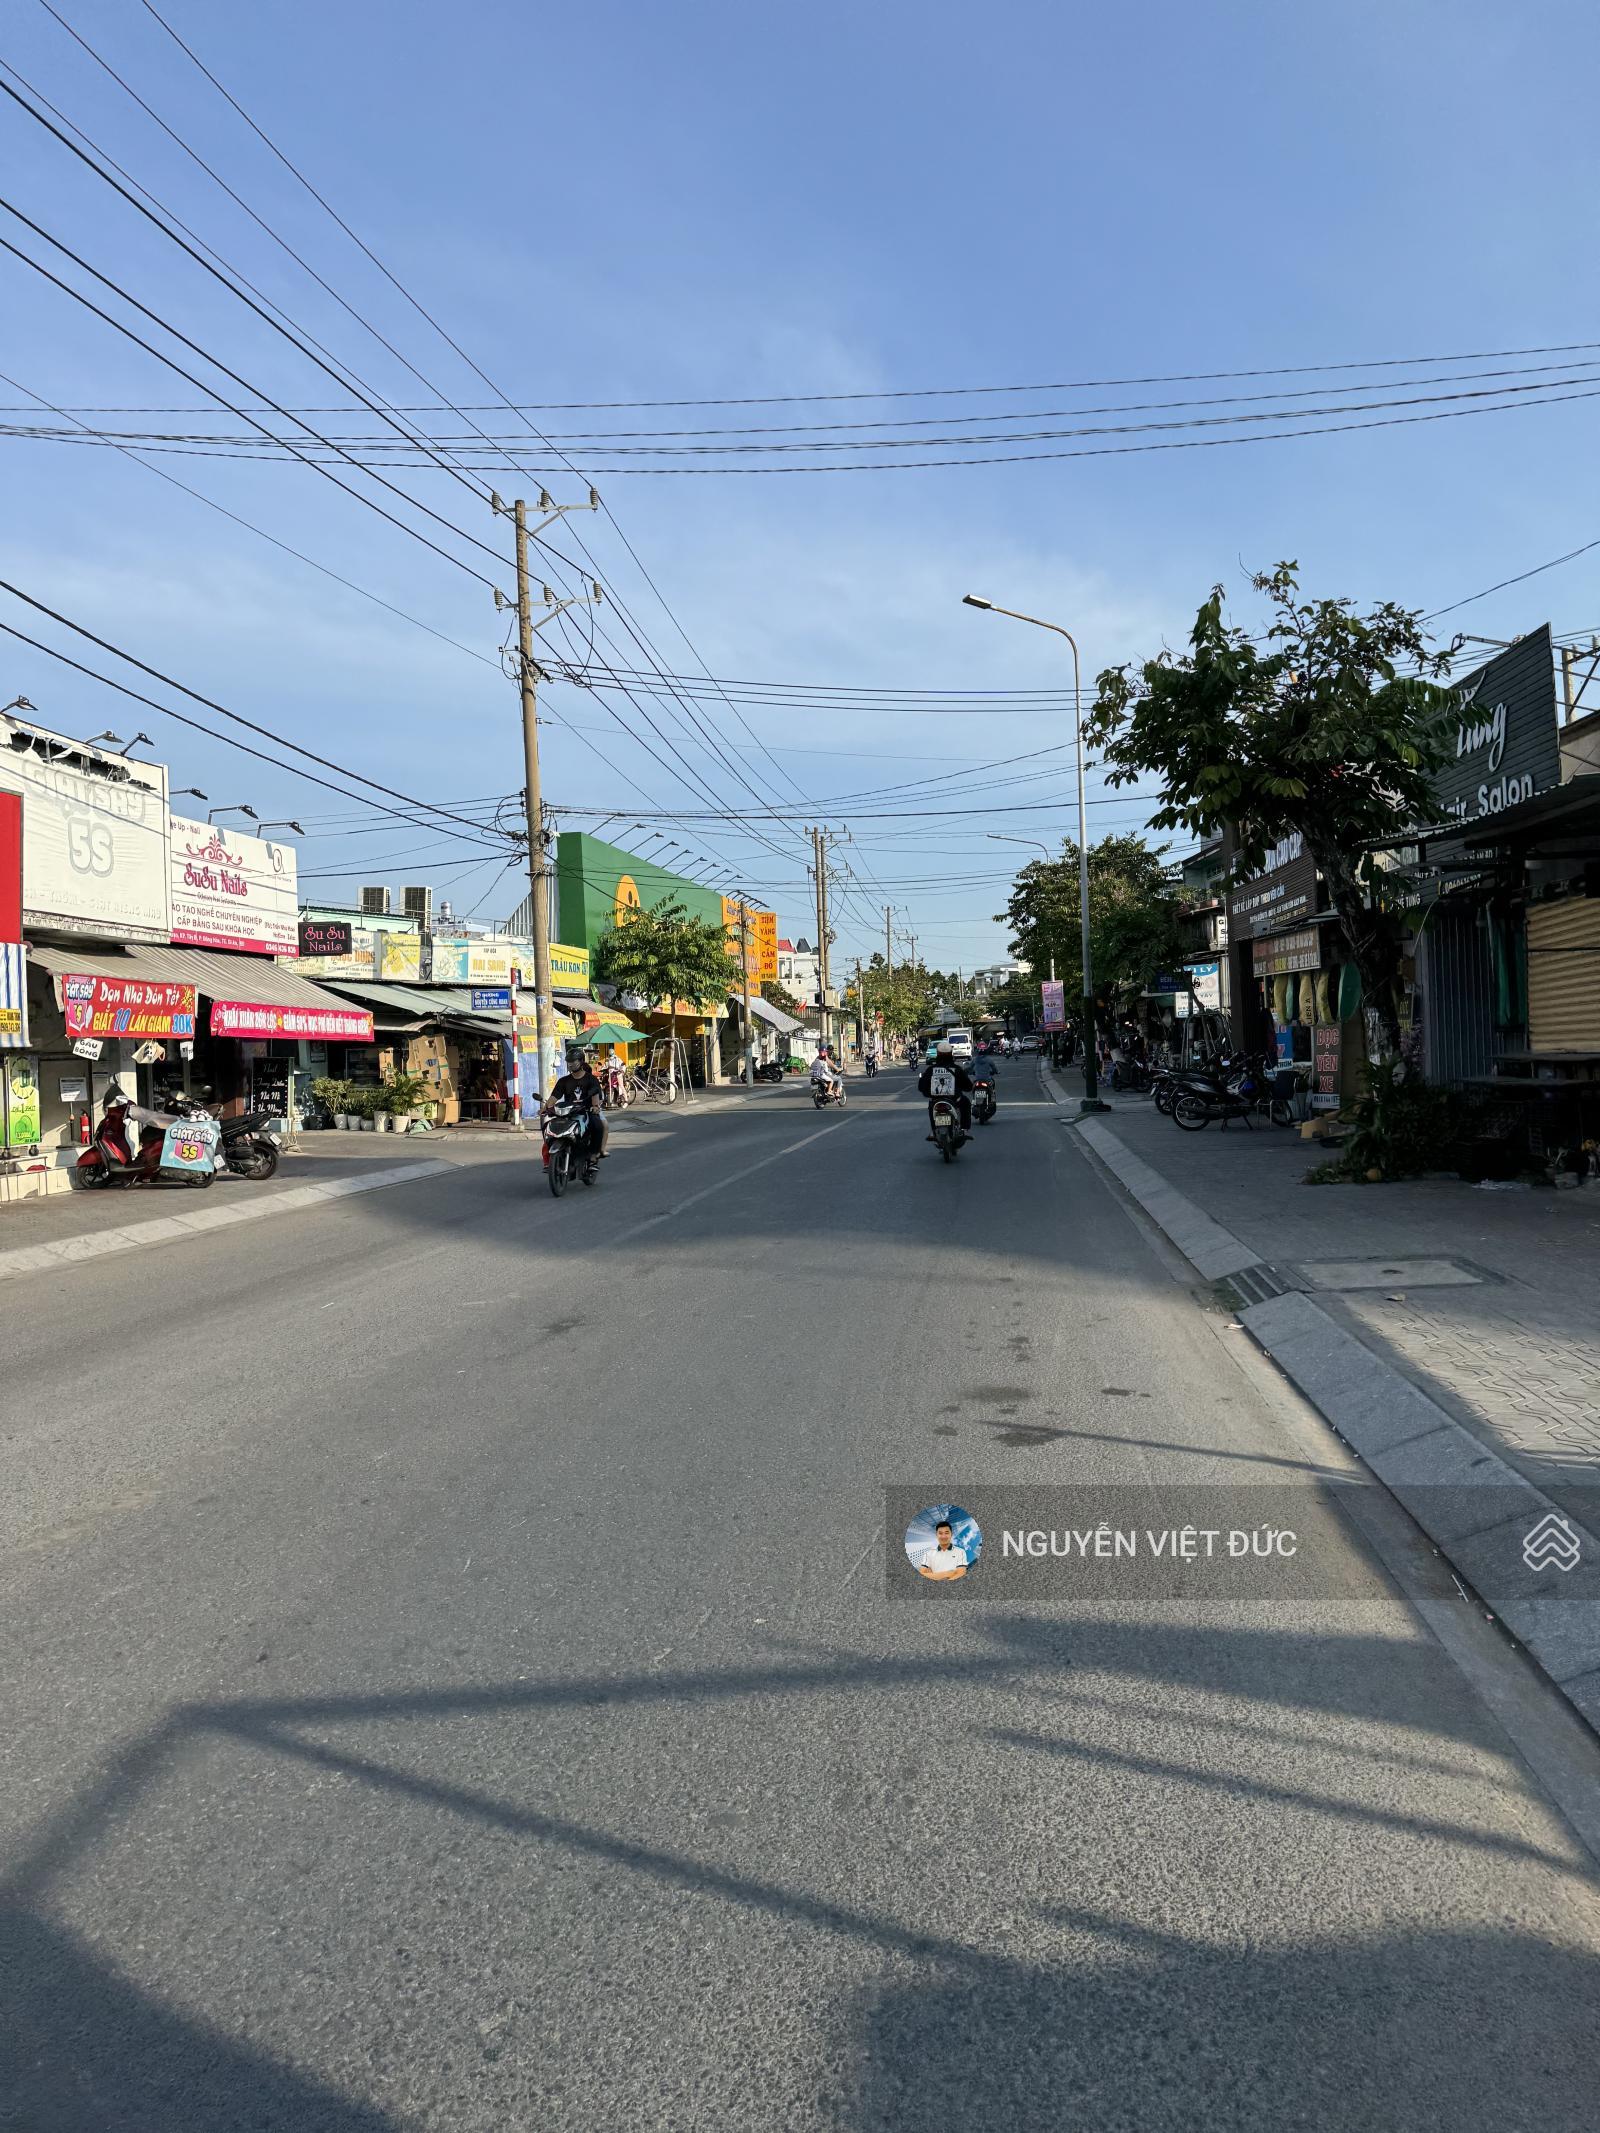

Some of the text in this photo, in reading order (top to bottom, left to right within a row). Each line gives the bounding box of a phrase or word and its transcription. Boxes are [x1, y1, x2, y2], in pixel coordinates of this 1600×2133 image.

[1478, 773, 1534, 817] Salon
[67, 815, 115, 879] 5S
[220, 869, 248, 897] Nails
[177, 914, 190, 925] CẤP
[212, 922, 224, 932] SAU
[242, 926, 255, 936] HỌC
[326, 926, 345, 940] Su
[309, 941, 343, 952] Nails
[124, 984, 143, 1004] Nhà
[145, 986, 163, 1006] Đón
[166, 984, 180, 1006] Tết
[114, 1008, 131, 1032] 10
[172, 1014, 192, 1034] 30K
[1316, 1028, 1340, 1048] BỌC
[1316, 1052, 1338, 1072] YÊN
[1319, 1075, 1334, 1093] XE
[170, 1126, 214, 1144] GIẶT SẤY
[182, 1144, 198, 1159] 5S
